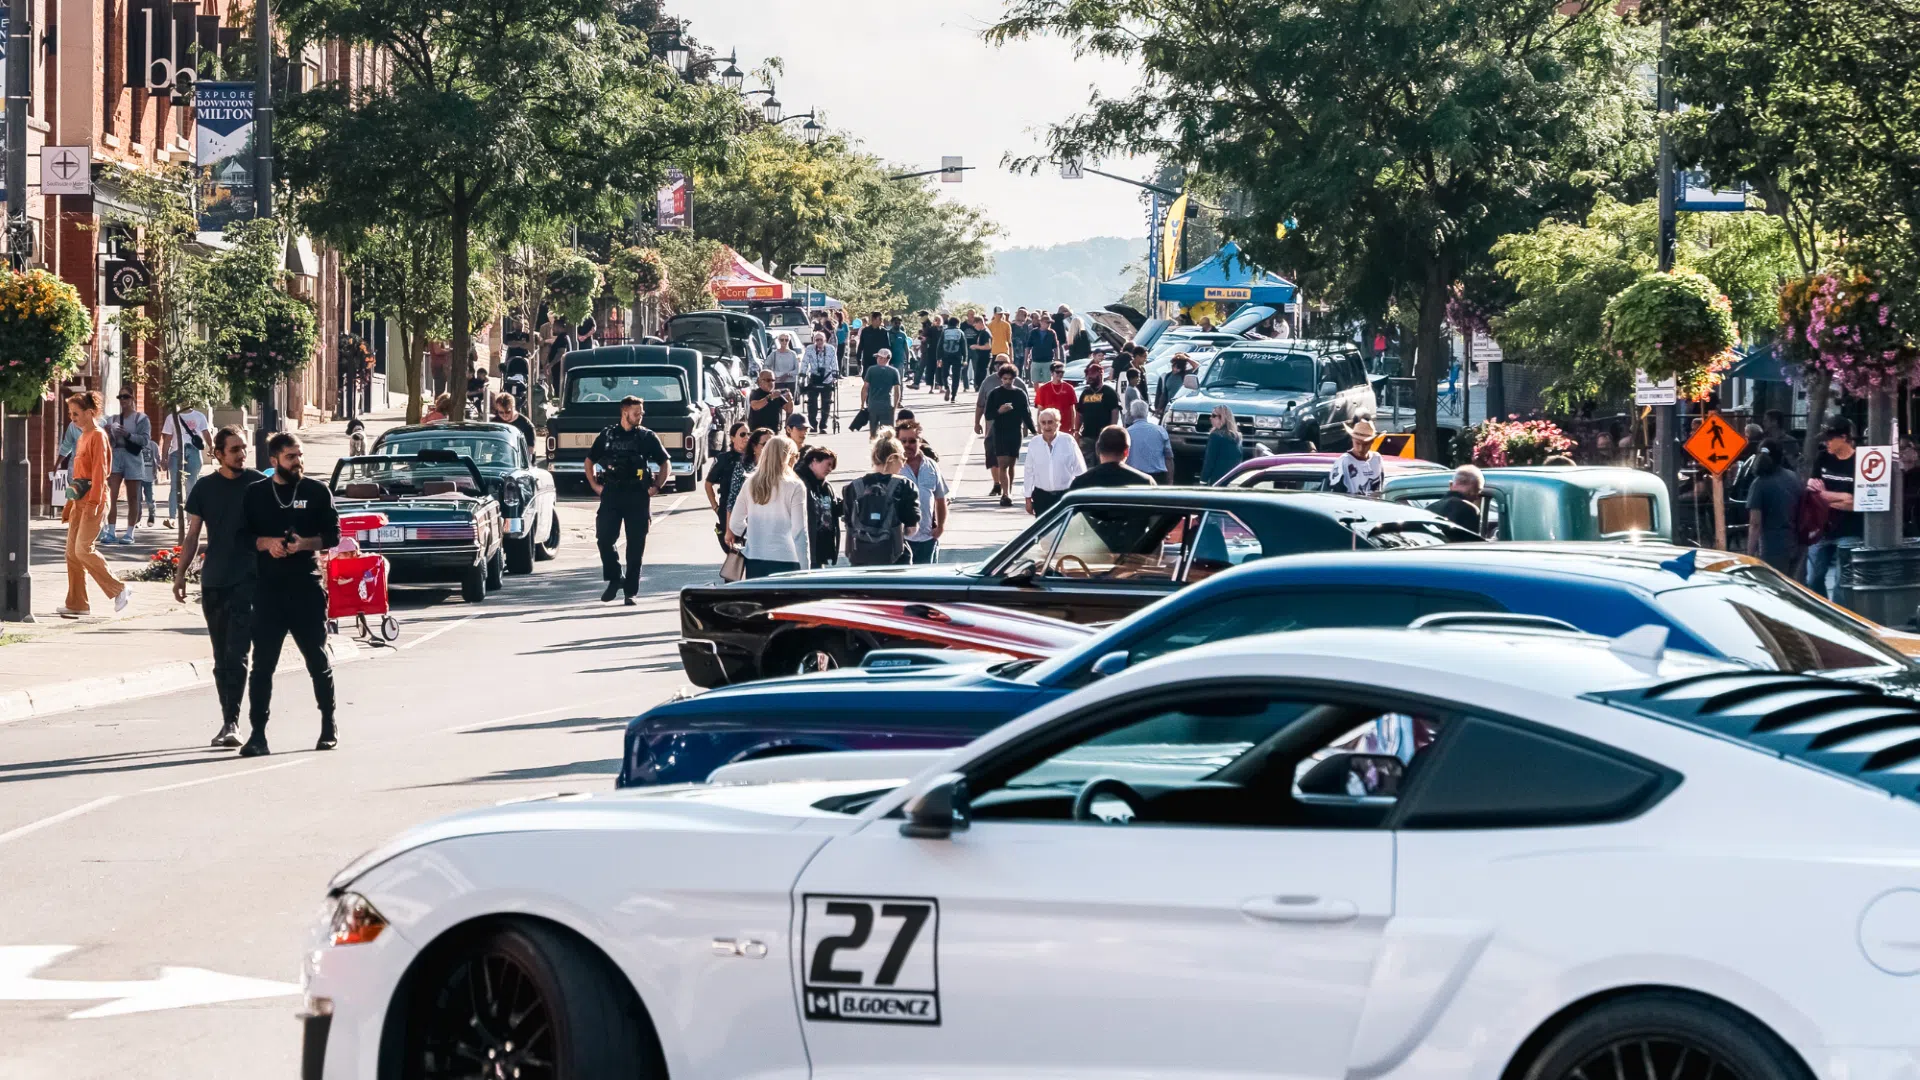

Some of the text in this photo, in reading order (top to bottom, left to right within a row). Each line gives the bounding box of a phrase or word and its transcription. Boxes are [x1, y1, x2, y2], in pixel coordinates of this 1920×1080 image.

[196, 91, 254, 99] EXPLORE
[197, 108, 253, 120] MILTON
[726, 289, 747, 298] Corn
[293, 499, 308, 509] CAT
[809, 901, 931, 986] 27
[842, 996, 930, 1016] B.GOENCZ
